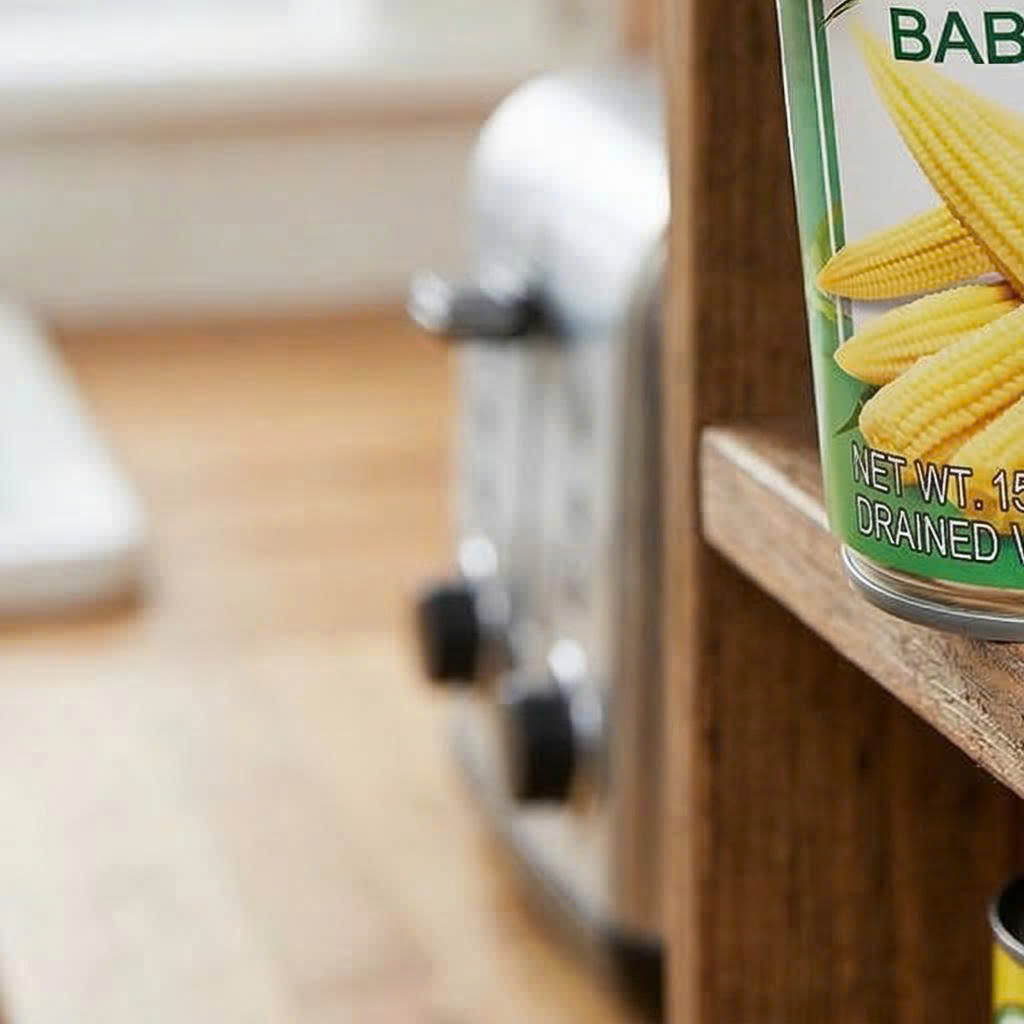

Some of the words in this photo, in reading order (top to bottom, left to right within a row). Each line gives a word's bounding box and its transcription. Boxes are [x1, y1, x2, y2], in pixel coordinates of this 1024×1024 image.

[851, 440, 906, 496] NET
[915, 461, 984, 509] WT.
[855, 495, 998, 563] DRAINED
